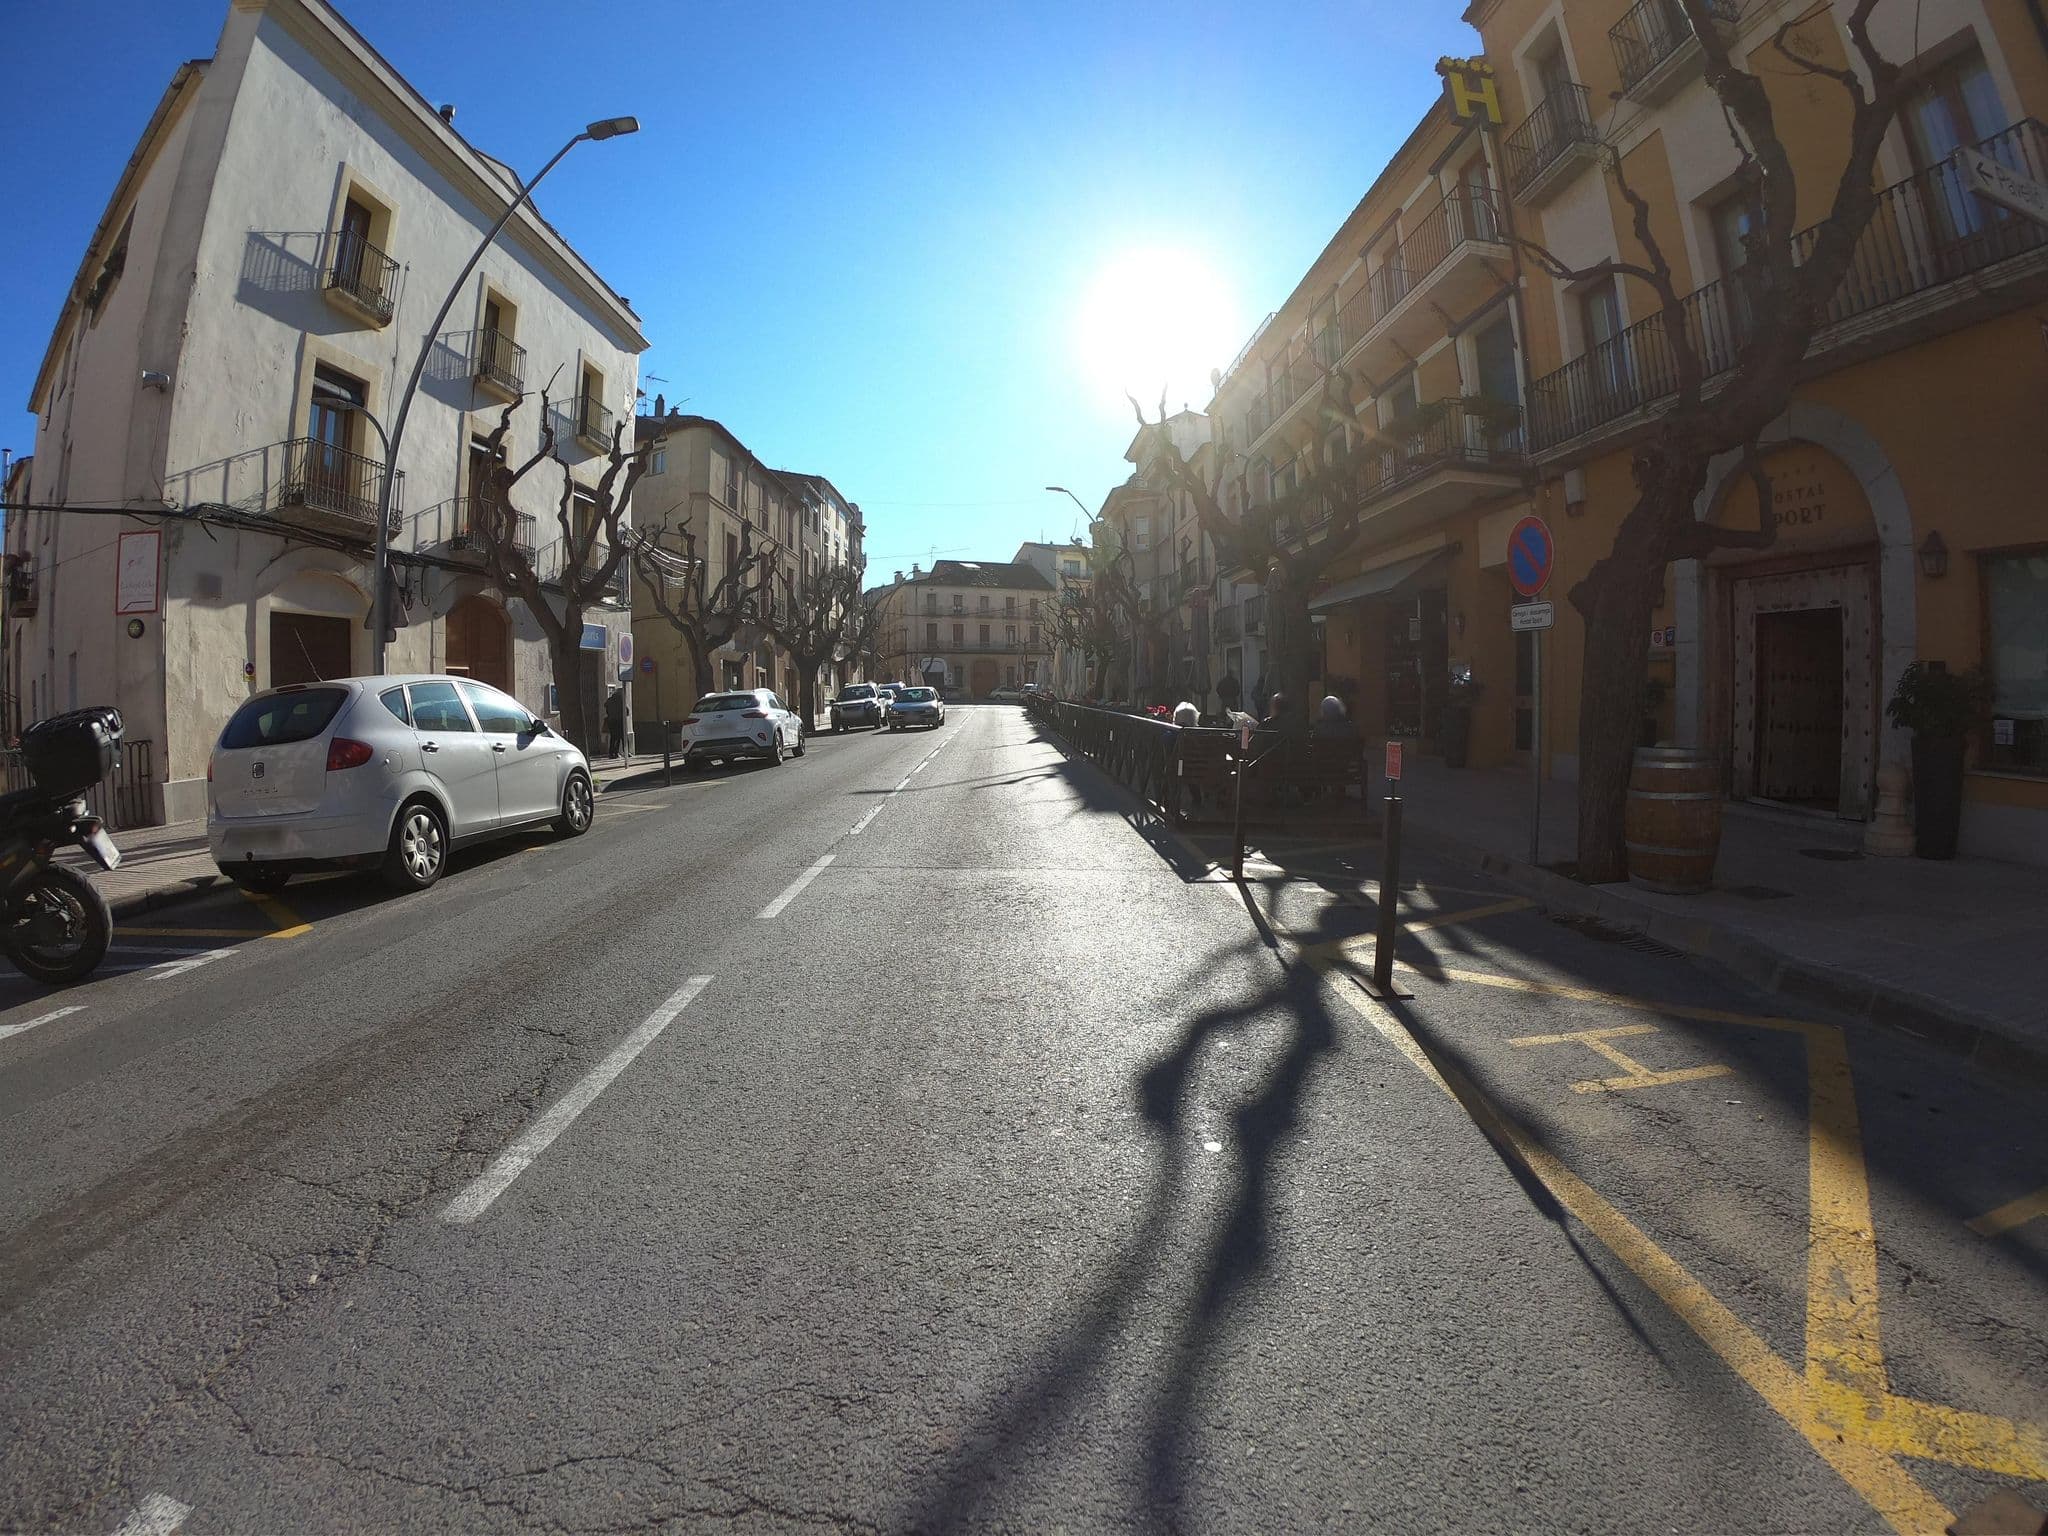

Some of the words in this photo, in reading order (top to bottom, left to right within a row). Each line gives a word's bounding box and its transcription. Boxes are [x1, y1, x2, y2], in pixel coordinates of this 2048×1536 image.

[1449, 71, 1502, 124] H
[1774, 483, 1825, 503] OSTAL
[1774, 504, 1826, 527] PORT
